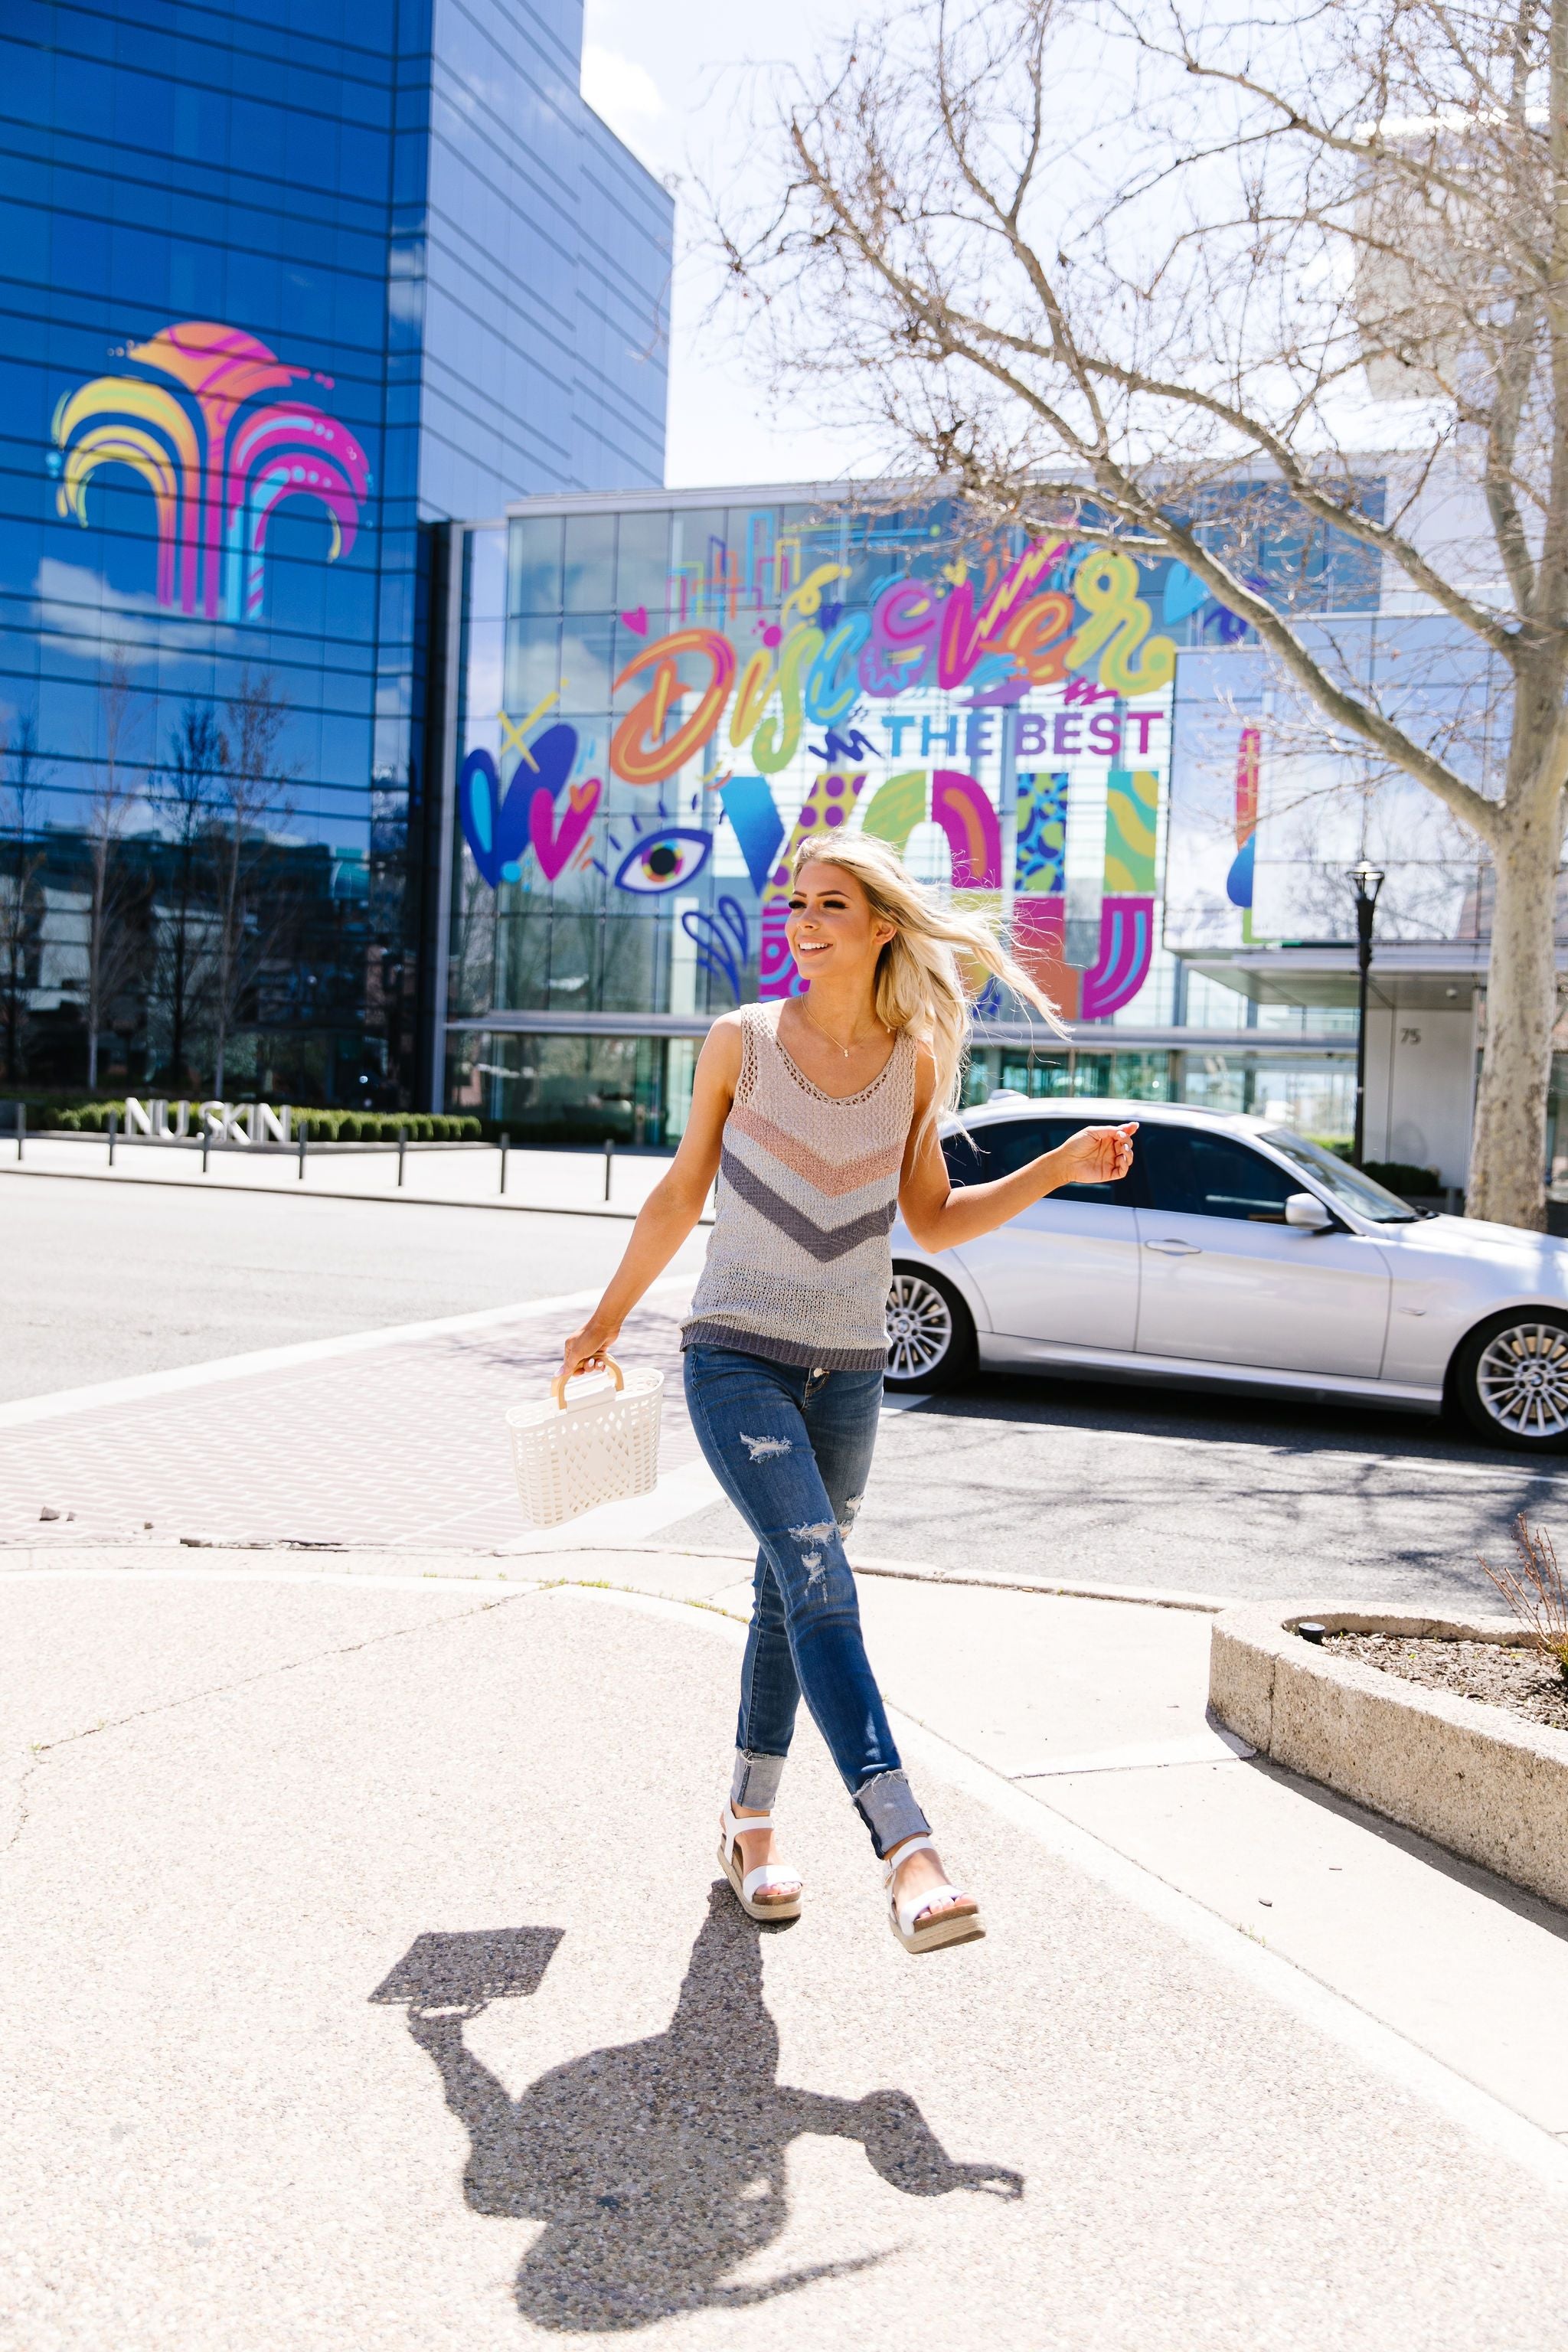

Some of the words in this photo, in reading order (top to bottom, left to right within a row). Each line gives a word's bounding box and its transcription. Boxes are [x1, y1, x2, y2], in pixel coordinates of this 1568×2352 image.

[882, 714, 995, 757] THE
[1016, 711, 1165, 756] BEST
[1400, 1027, 1422, 1045] 75
[125, 1096, 191, 1141] NU
[196, 1100, 292, 1146] SKIN
